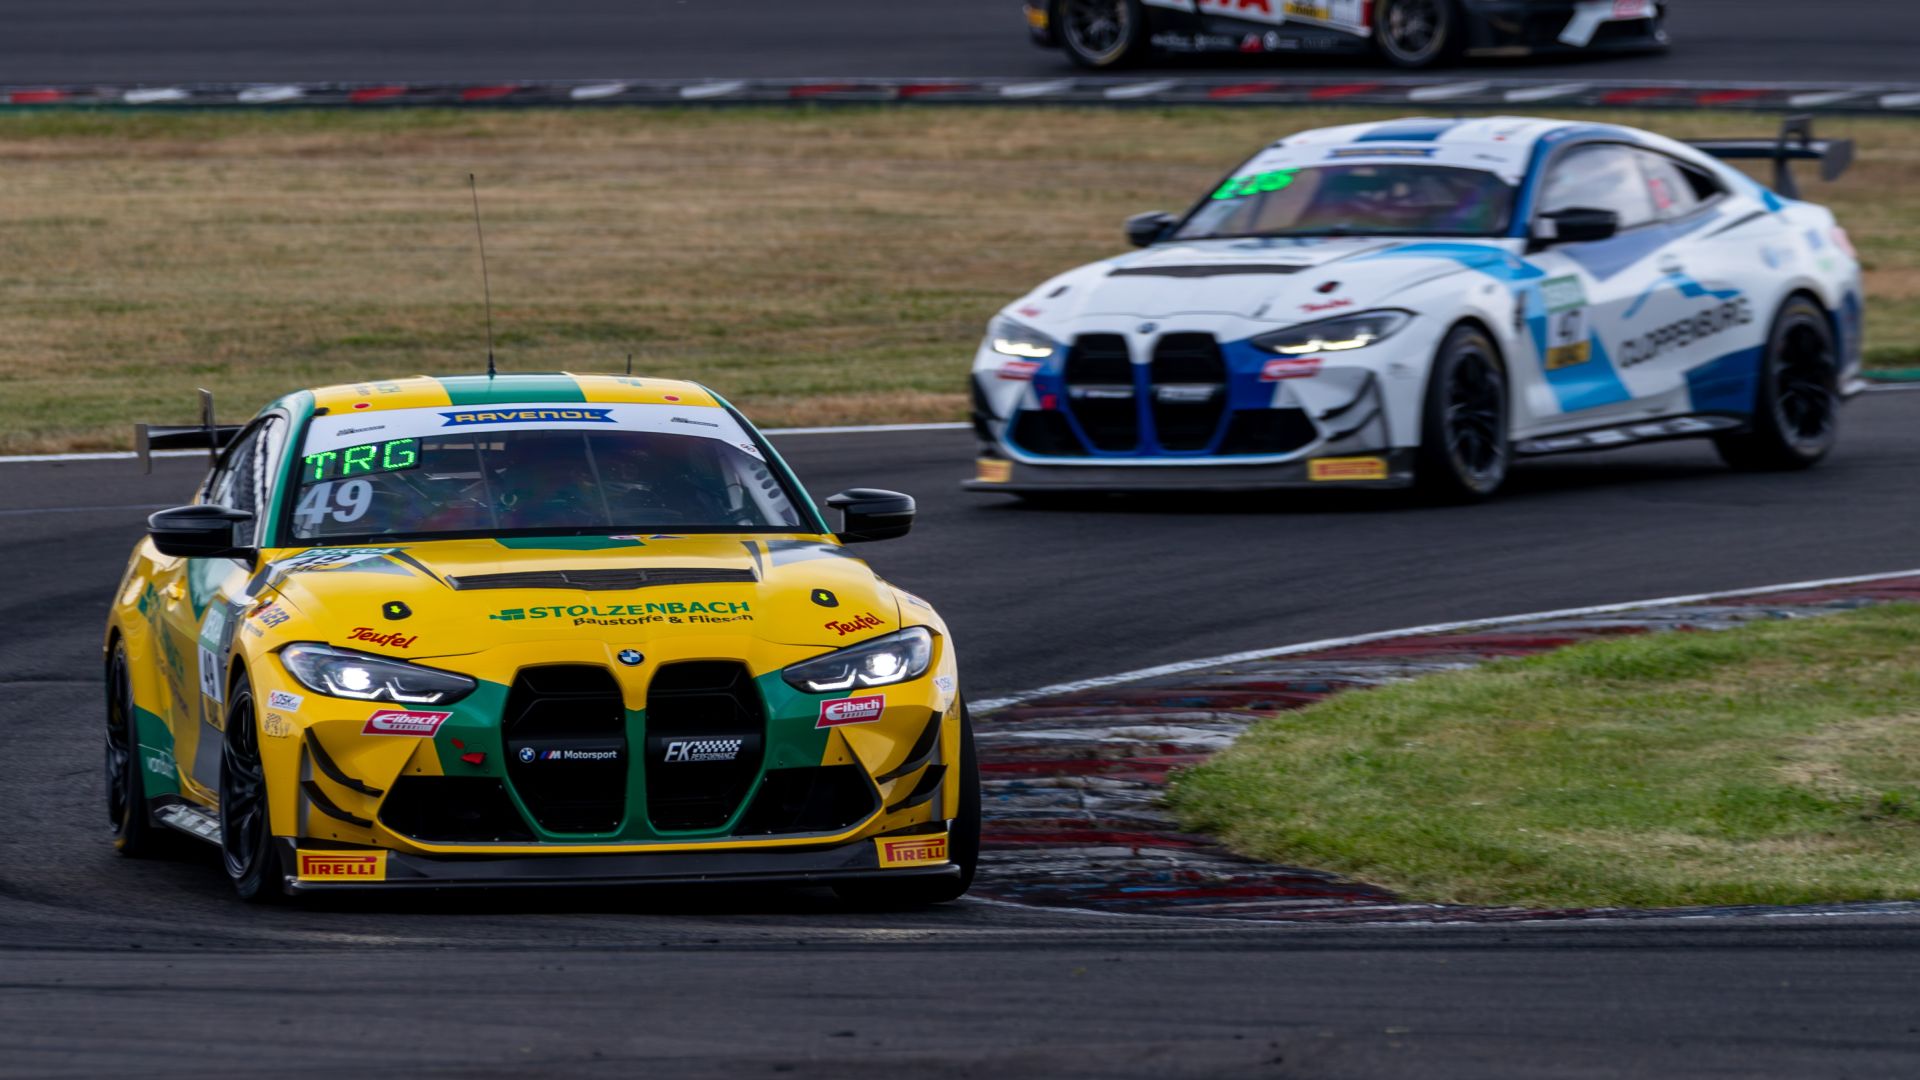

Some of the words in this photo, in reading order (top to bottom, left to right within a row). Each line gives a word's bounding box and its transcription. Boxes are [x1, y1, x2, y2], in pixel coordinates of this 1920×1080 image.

[455, 411, 602, 423] RAVENOL
[305, 438, 416, 480] TRG
[293, 480, 373, 523] 49
[529, 601, 750, 619] STOLZENBACH
[573, 614, 663, 626] Baustoffe
[668, 616, 684, 624] &
[824, 612, 885, 636] Teufel
[347, 627, 418, 649] Teufel
[826, 699, 880, 720] Eibach
[372, 713, 440, 731] Eibach
[564, 750, 617, 761] Motorsport
[664, 741, 695, 762] FK
[691, 752, 737, 760] PERFORMANCE
[884, 838, 945, 862] PIRELLI
[302, 855, 377, 876] PIRELLI
